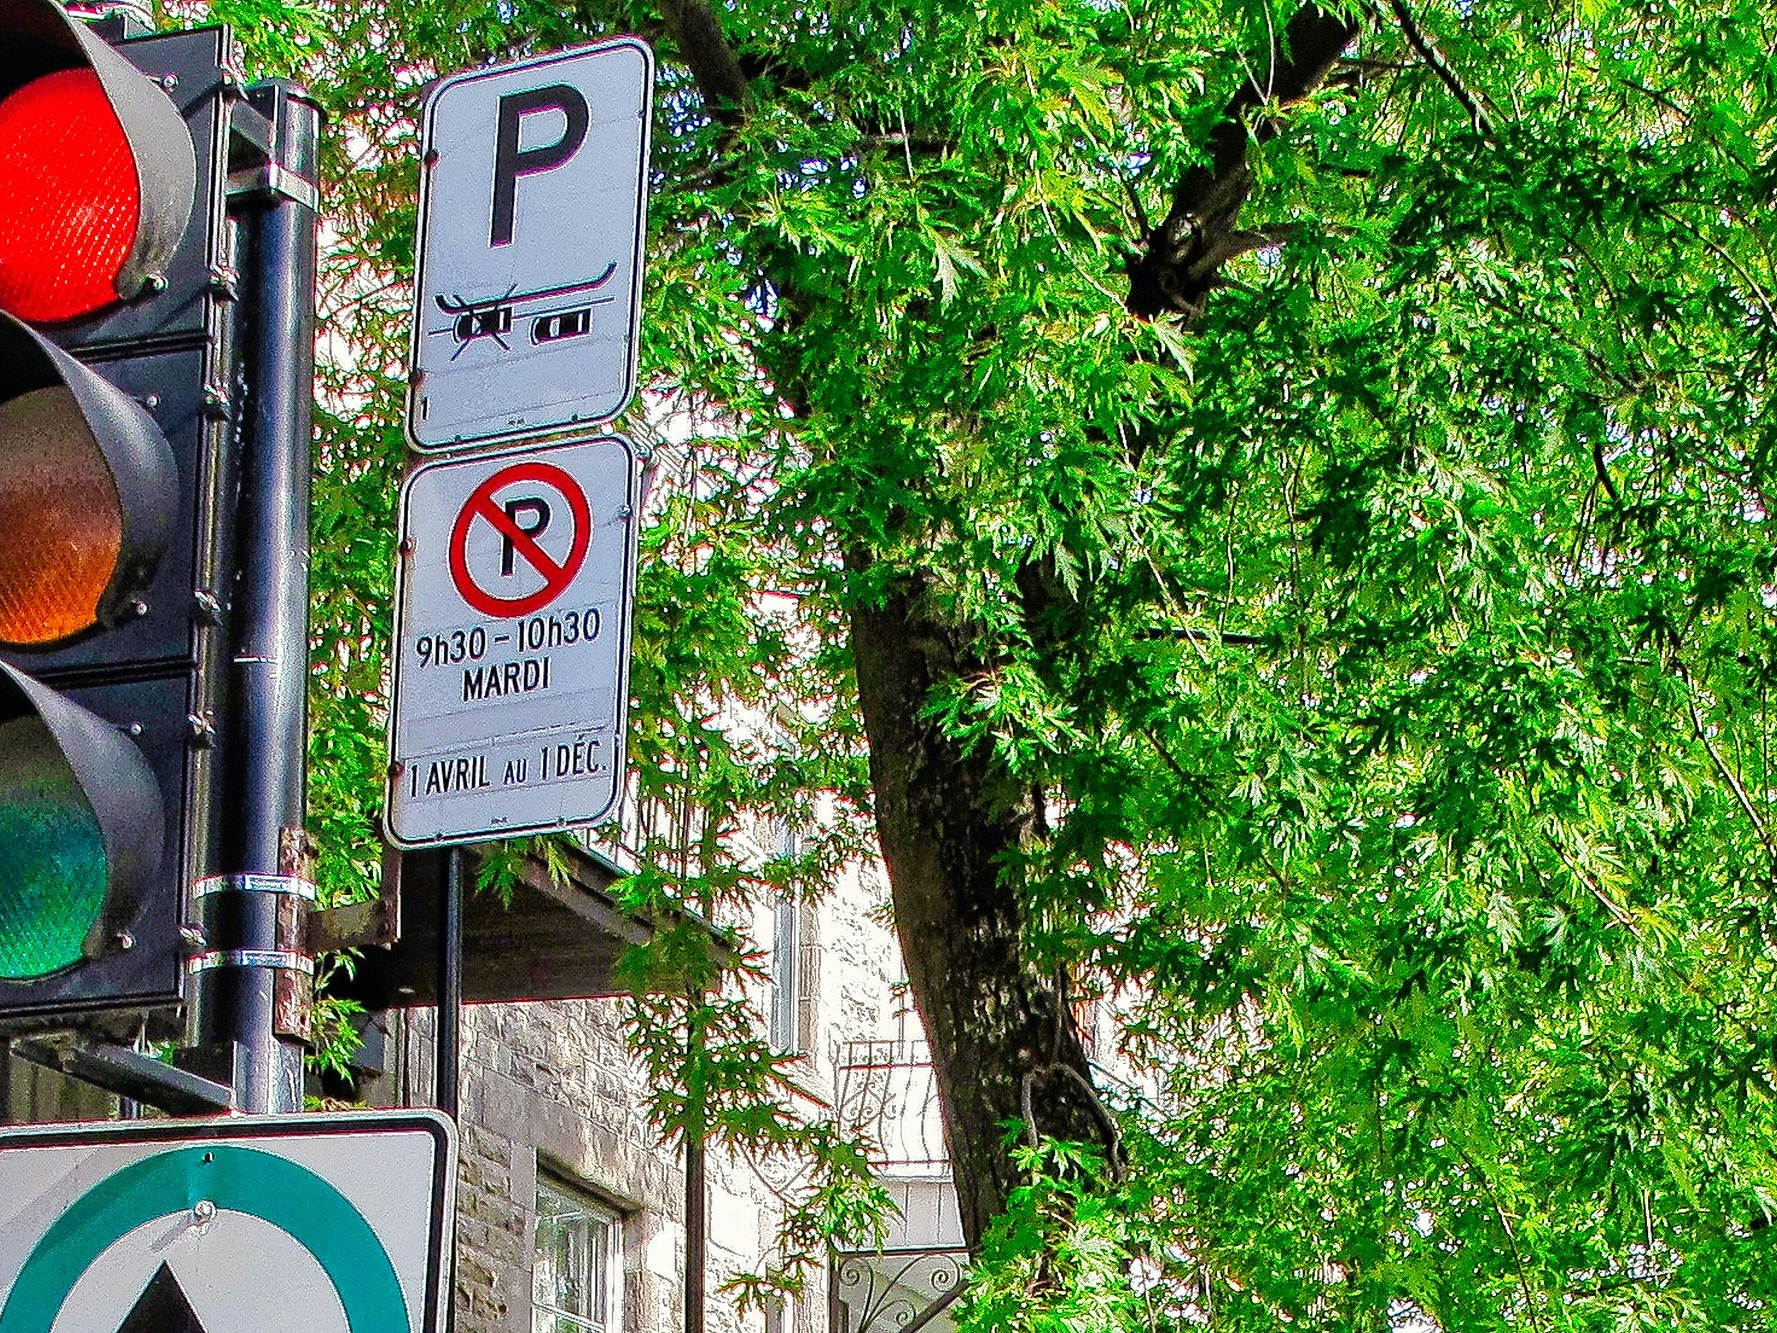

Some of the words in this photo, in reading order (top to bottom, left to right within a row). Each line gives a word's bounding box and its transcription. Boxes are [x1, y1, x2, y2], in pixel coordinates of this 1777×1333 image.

[490, 81, 590, 248] P
[500, 496, 553, 576] P
[415, 626, 487, 668] 9h30
[517, 607, 602, 653] 10h30
[462, 656, 551, 702] MARDI
[410, 764, 418, 798] 1
[425, 755, 491, 796] AVRIL
[502, 758, 529, 786] AU
[541, 746, 549, 782] 1
[555, 734, 608, 778] DÉC.
